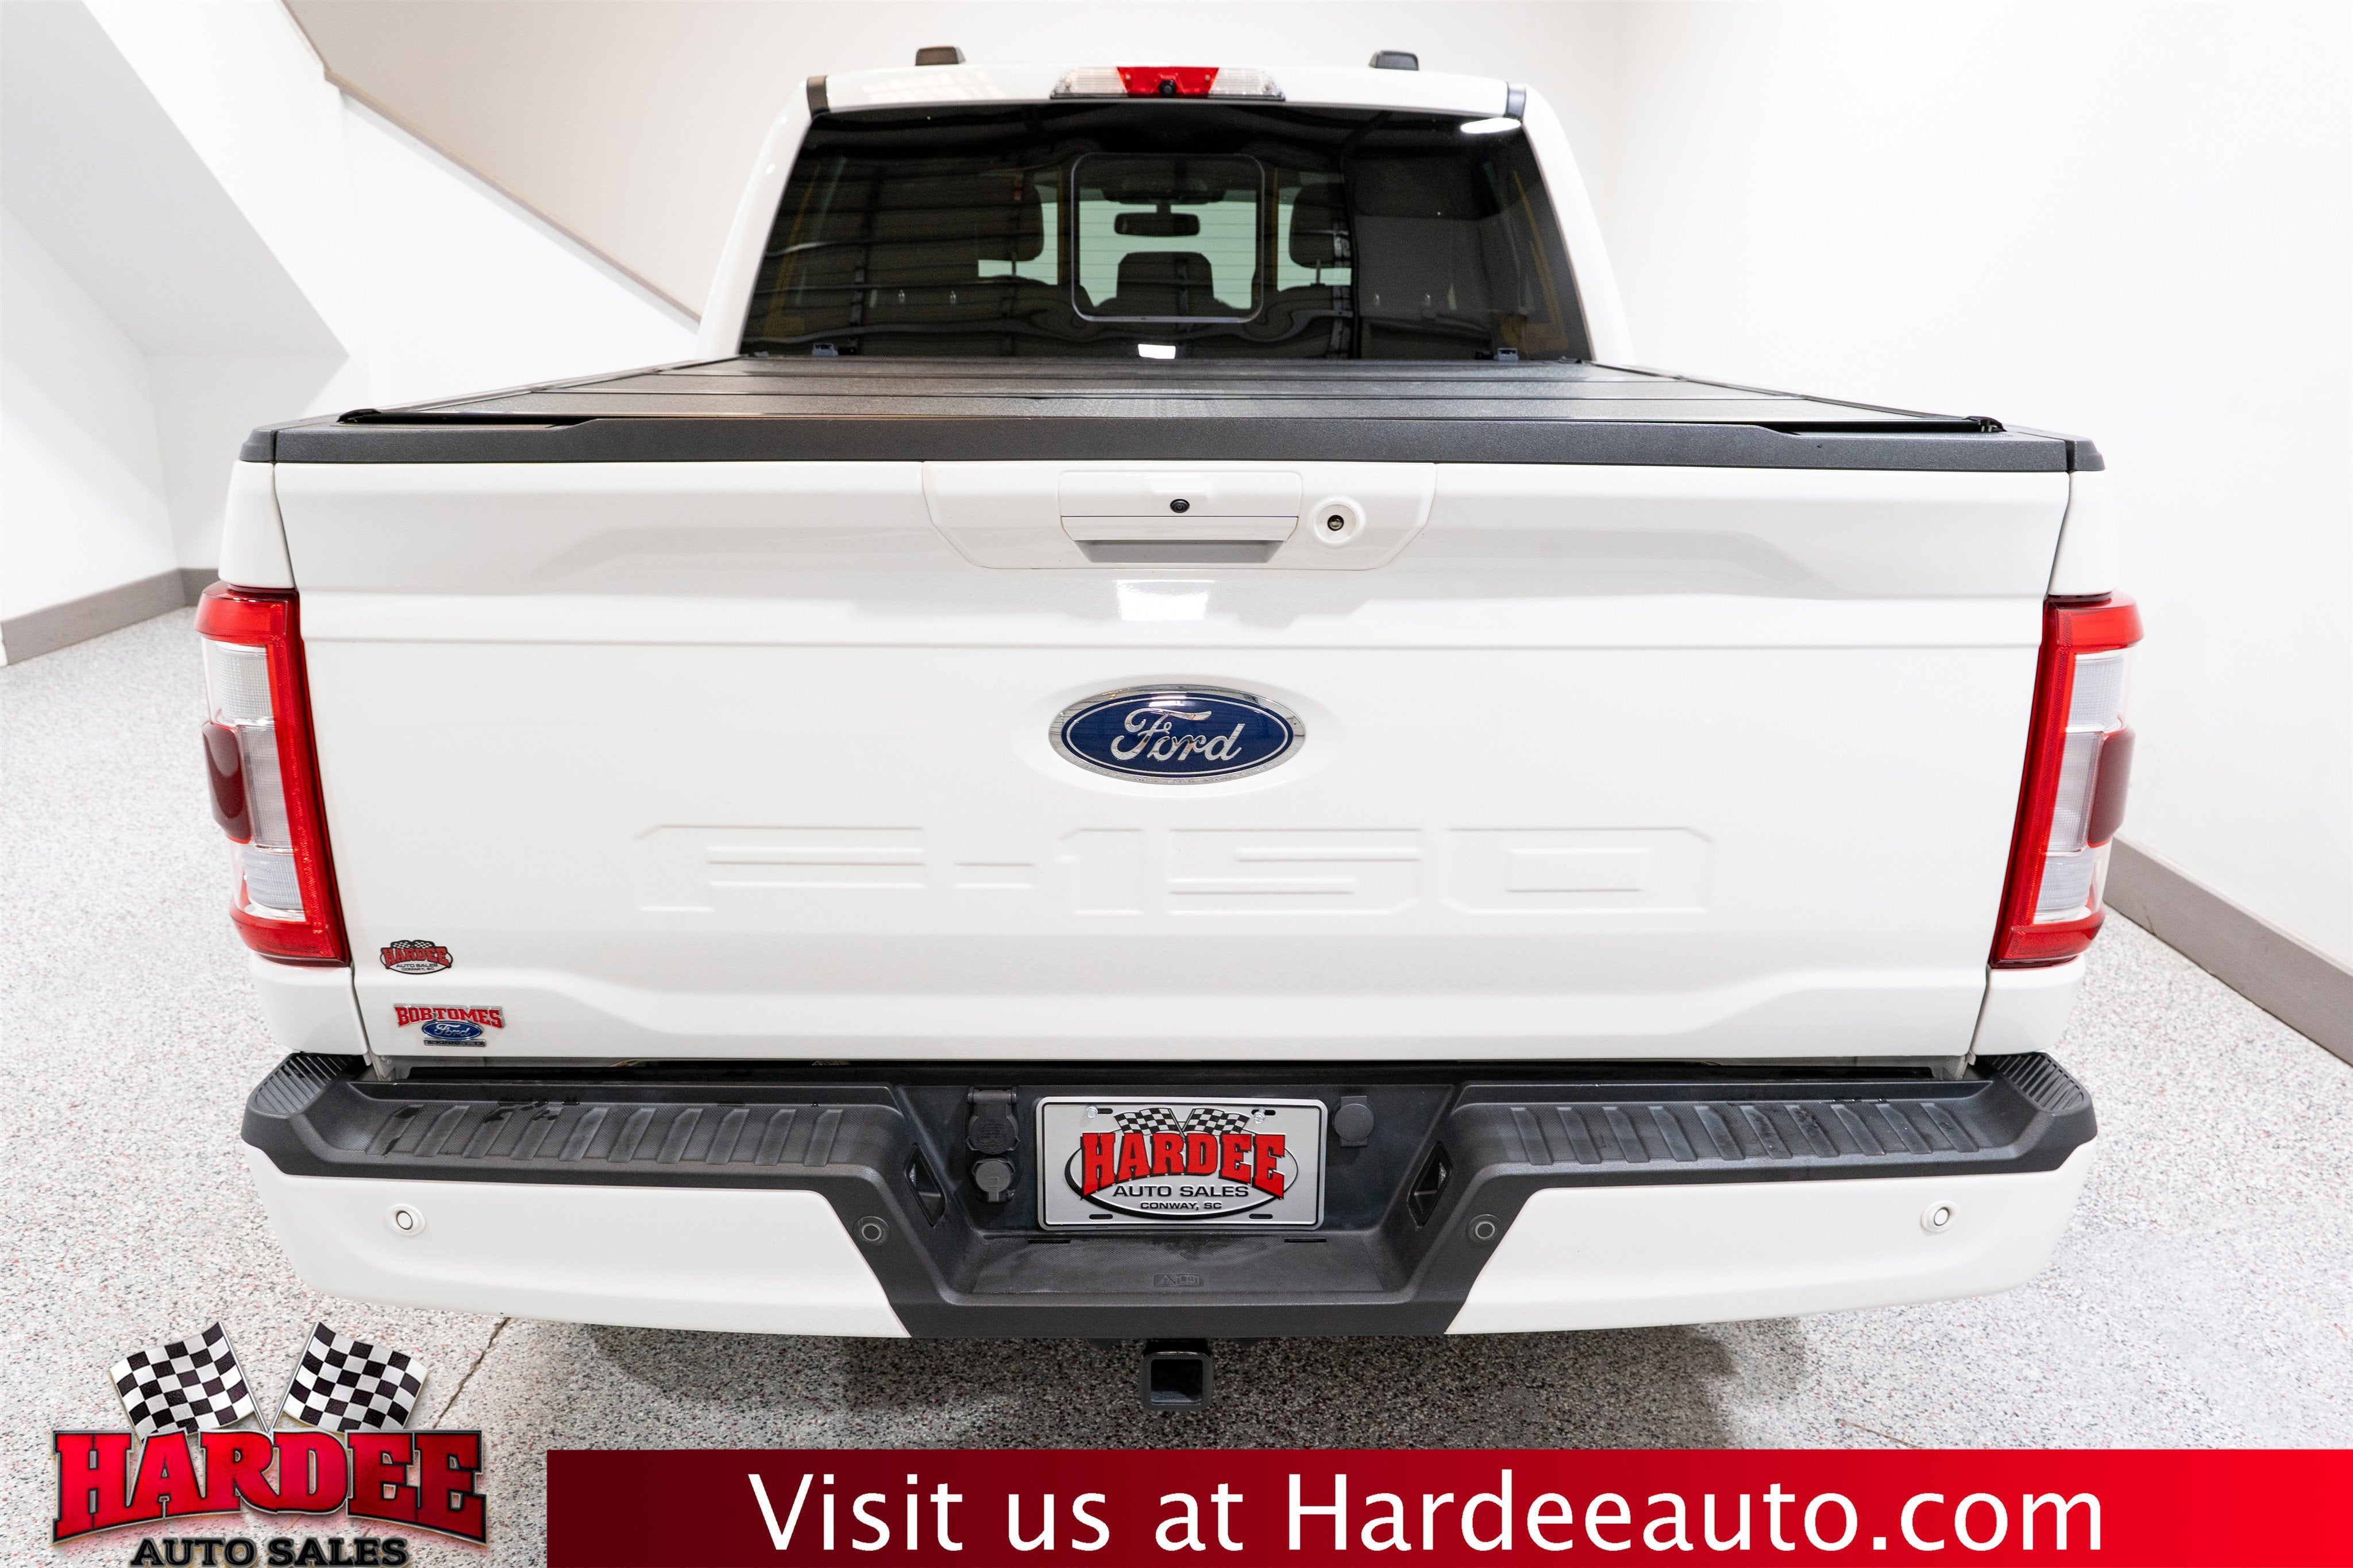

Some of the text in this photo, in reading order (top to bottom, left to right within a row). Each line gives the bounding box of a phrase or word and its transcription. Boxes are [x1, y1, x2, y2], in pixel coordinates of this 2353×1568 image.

[1110, 707, 1245, 761] Ford
[634, 824, 1715, 916] F-150
[381, 947, 450, 967] HARDEE
[435, 1023, 471, 1037] Ford
[1080, 1132, 1286, 1199] HARDEE
[1112, 1185, 1249, 1198] AUTO SALES
[1140, 1201, 1222, 1210] CONWAY, SC
